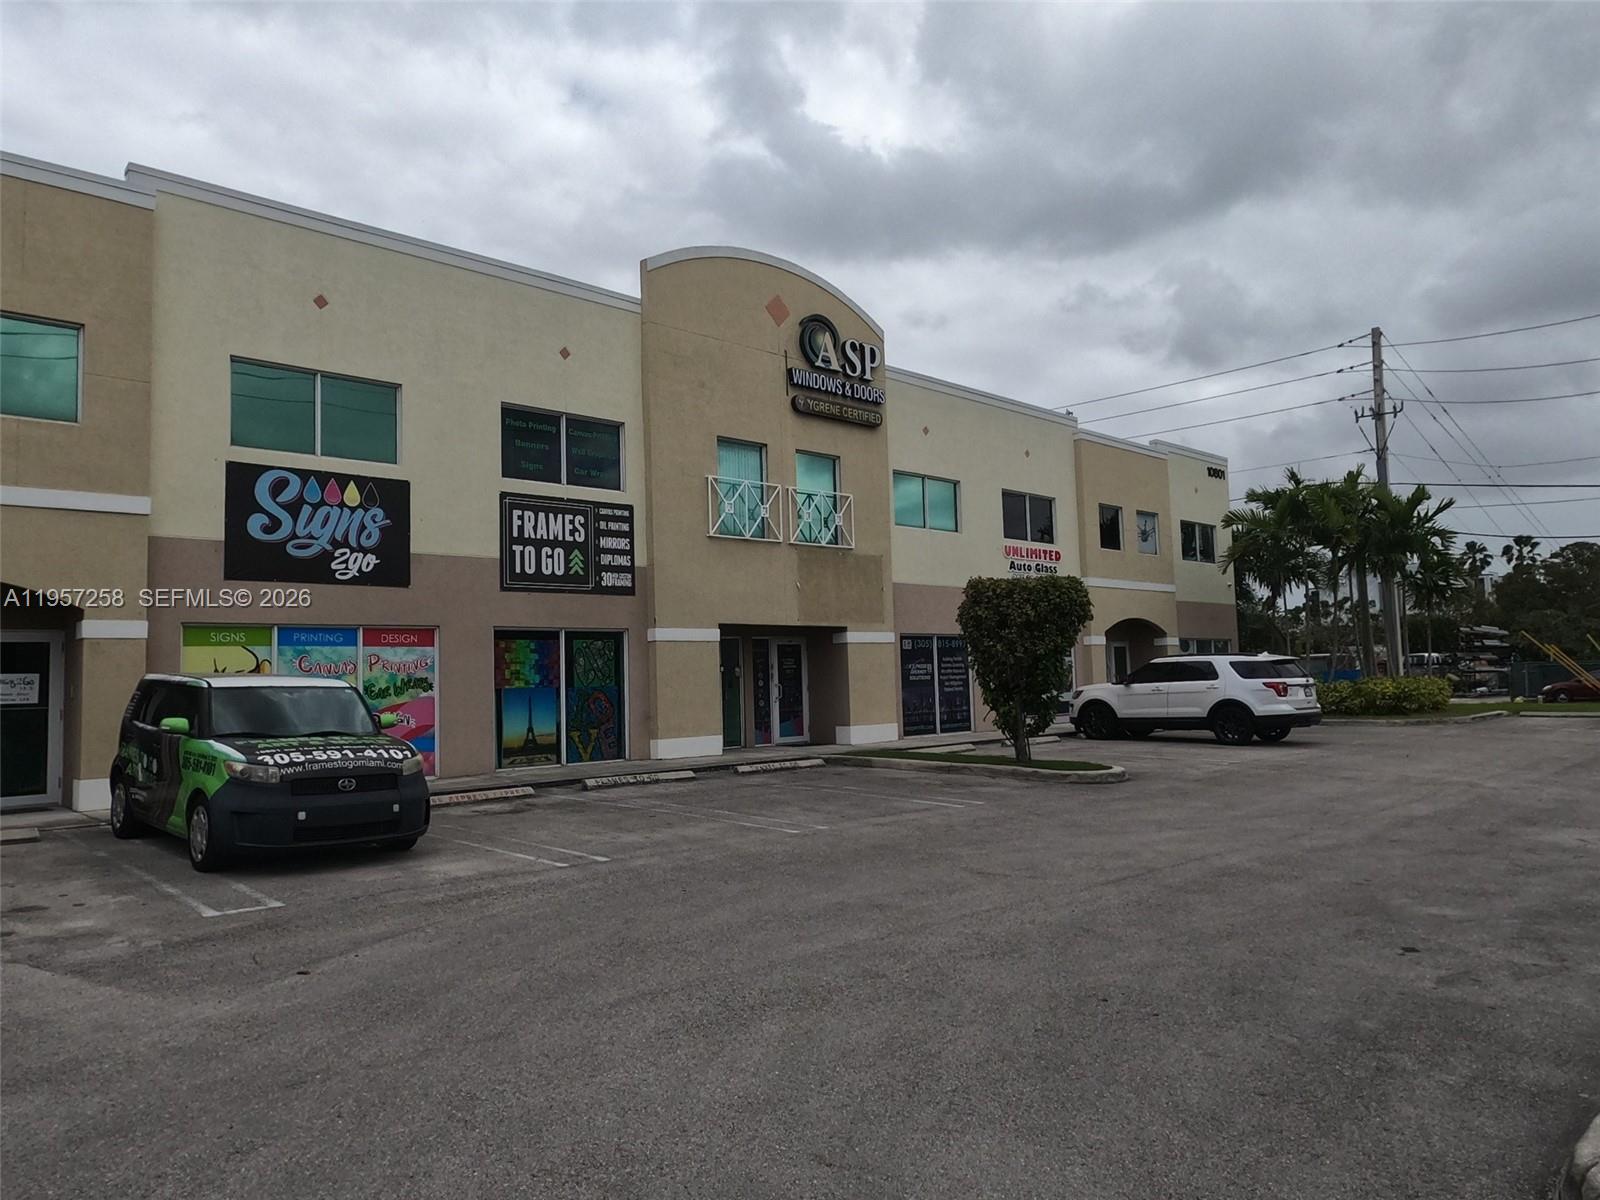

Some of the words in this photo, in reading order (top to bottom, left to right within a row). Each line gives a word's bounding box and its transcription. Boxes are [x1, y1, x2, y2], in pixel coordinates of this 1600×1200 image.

[815, 331, 881, 381] ASP
[792, 367, 842, 394] WINDOWS
[845, 381, 852, 396] &
[853, 384, 885, 404] DOORS
[807, 399, 841, 416] YGRENE
[842, 407, 882, 424] CERTIFIED
[246, 469, 392, 559] Signs
[512, 509, 585, 542] FRAMES
[599, 536, 631, 549] MIRRORS
[512, 544, 536, 574] TO
[541, 546, 565, 576] GO
[600, 553, 632, 566] DIPLOMAS
[1004, 545, 1062, 562] UNLIMITED
[331, 548, 381, 581] 2go
[1009, 560, 1032, 572] Auto
[1035, 563, 1058, 574] Glass
[601, 572, 612, 587] 30
[209, 632, 246, 642] SIGNS
[293, 632, 344, 643] PRINTING
[380, 633, 418, 643] DESIGN
[257, 749, 412, 766] 305-591-4101
